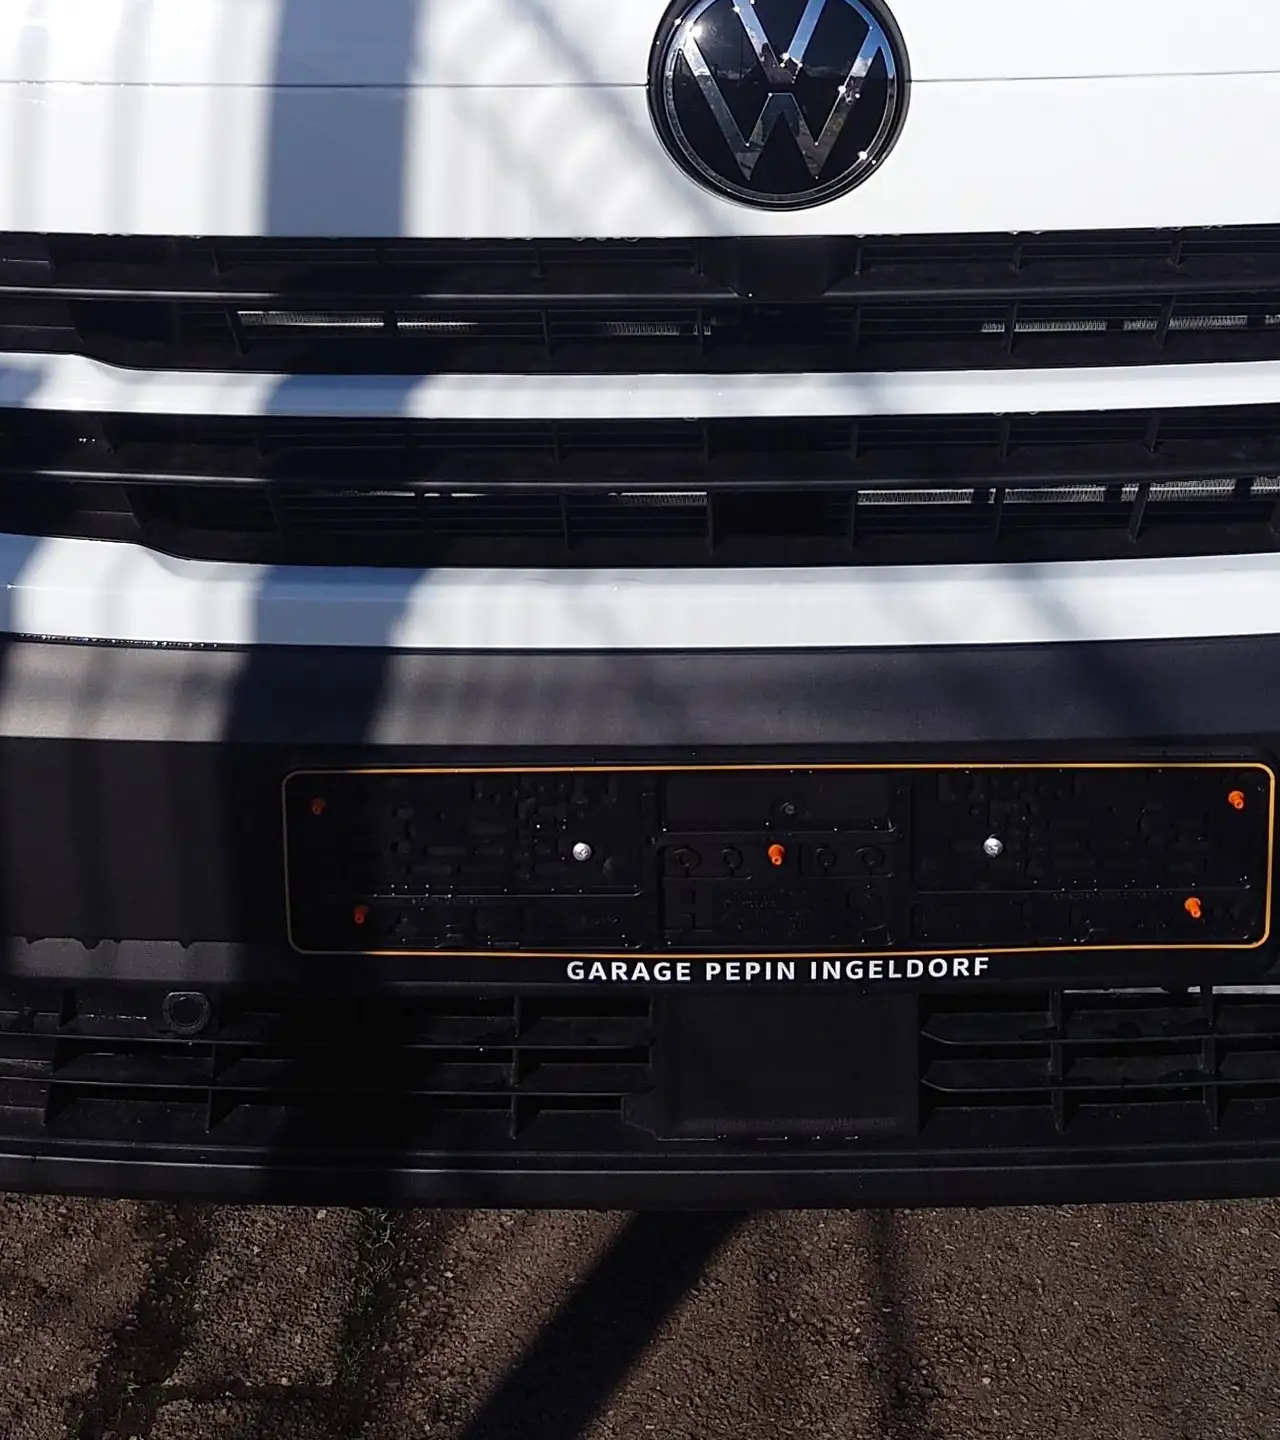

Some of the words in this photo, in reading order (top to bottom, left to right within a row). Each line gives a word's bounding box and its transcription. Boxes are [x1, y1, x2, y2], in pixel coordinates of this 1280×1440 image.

[566, 961, 691, 981] GARAGE
[705, 961, 795, 981] PEPIN
[810, 957, 989, 980] INGELDORF
